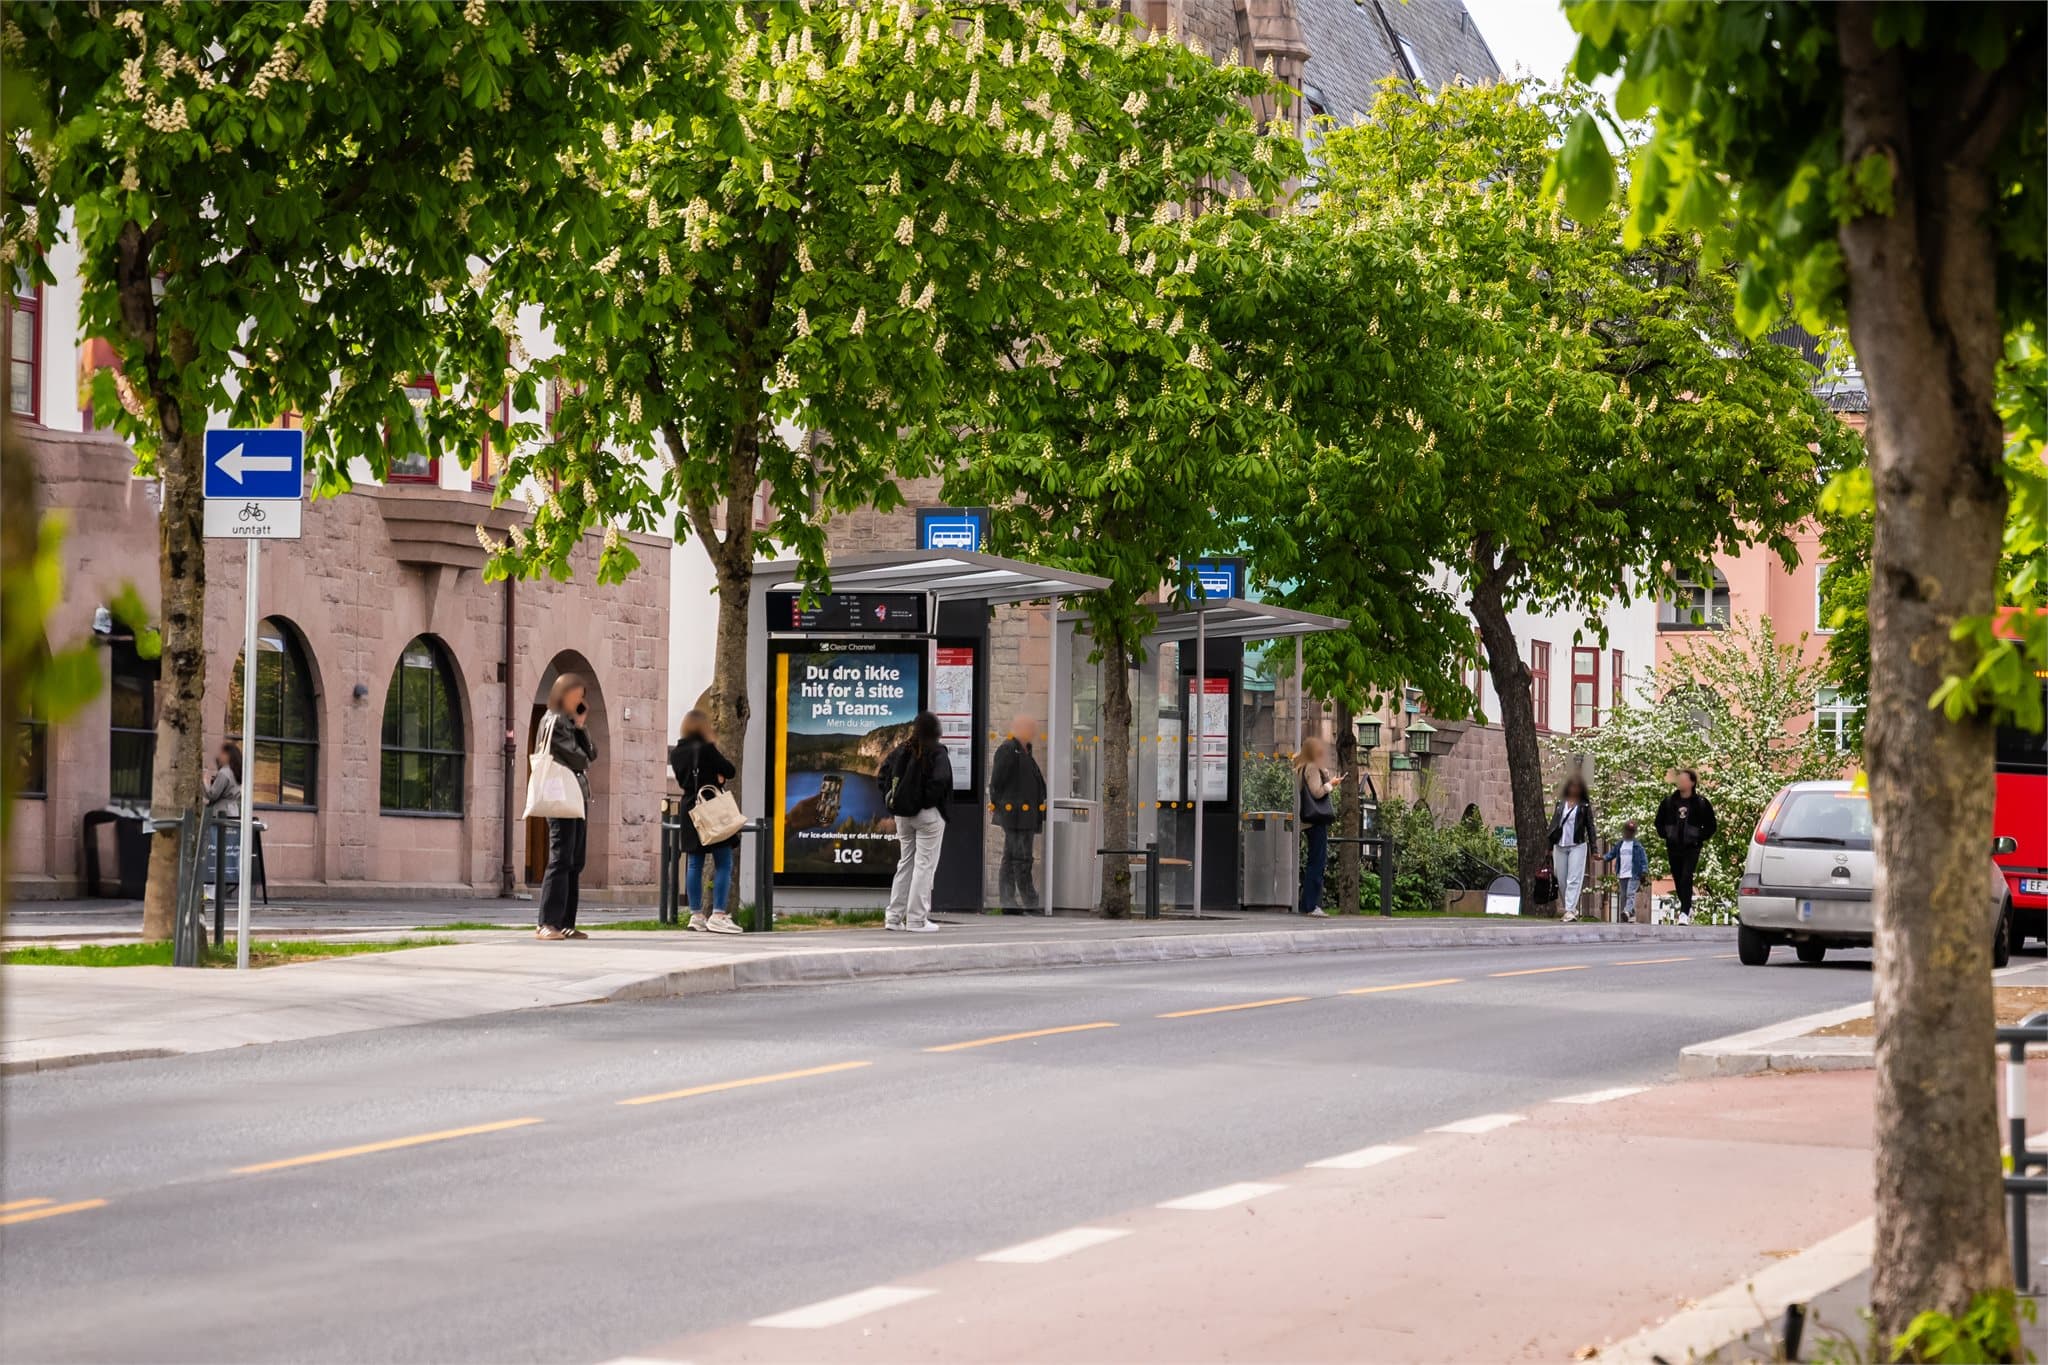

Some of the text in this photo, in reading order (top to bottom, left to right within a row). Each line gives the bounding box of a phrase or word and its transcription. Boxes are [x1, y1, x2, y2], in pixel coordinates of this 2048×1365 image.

[232, 526, 271, 535] unntatt
[806, 665, 900, 680] Du dro ikke
[802, 682, 904, 698] hit for å sitte
[812, 699, 892, 718] på Teams.
[827, 719, 845, 727] Men
[847, 718, 858, 728] du
[810, 832, 848, 840] ice-dekning
[834, 842, 863, 864] ice
